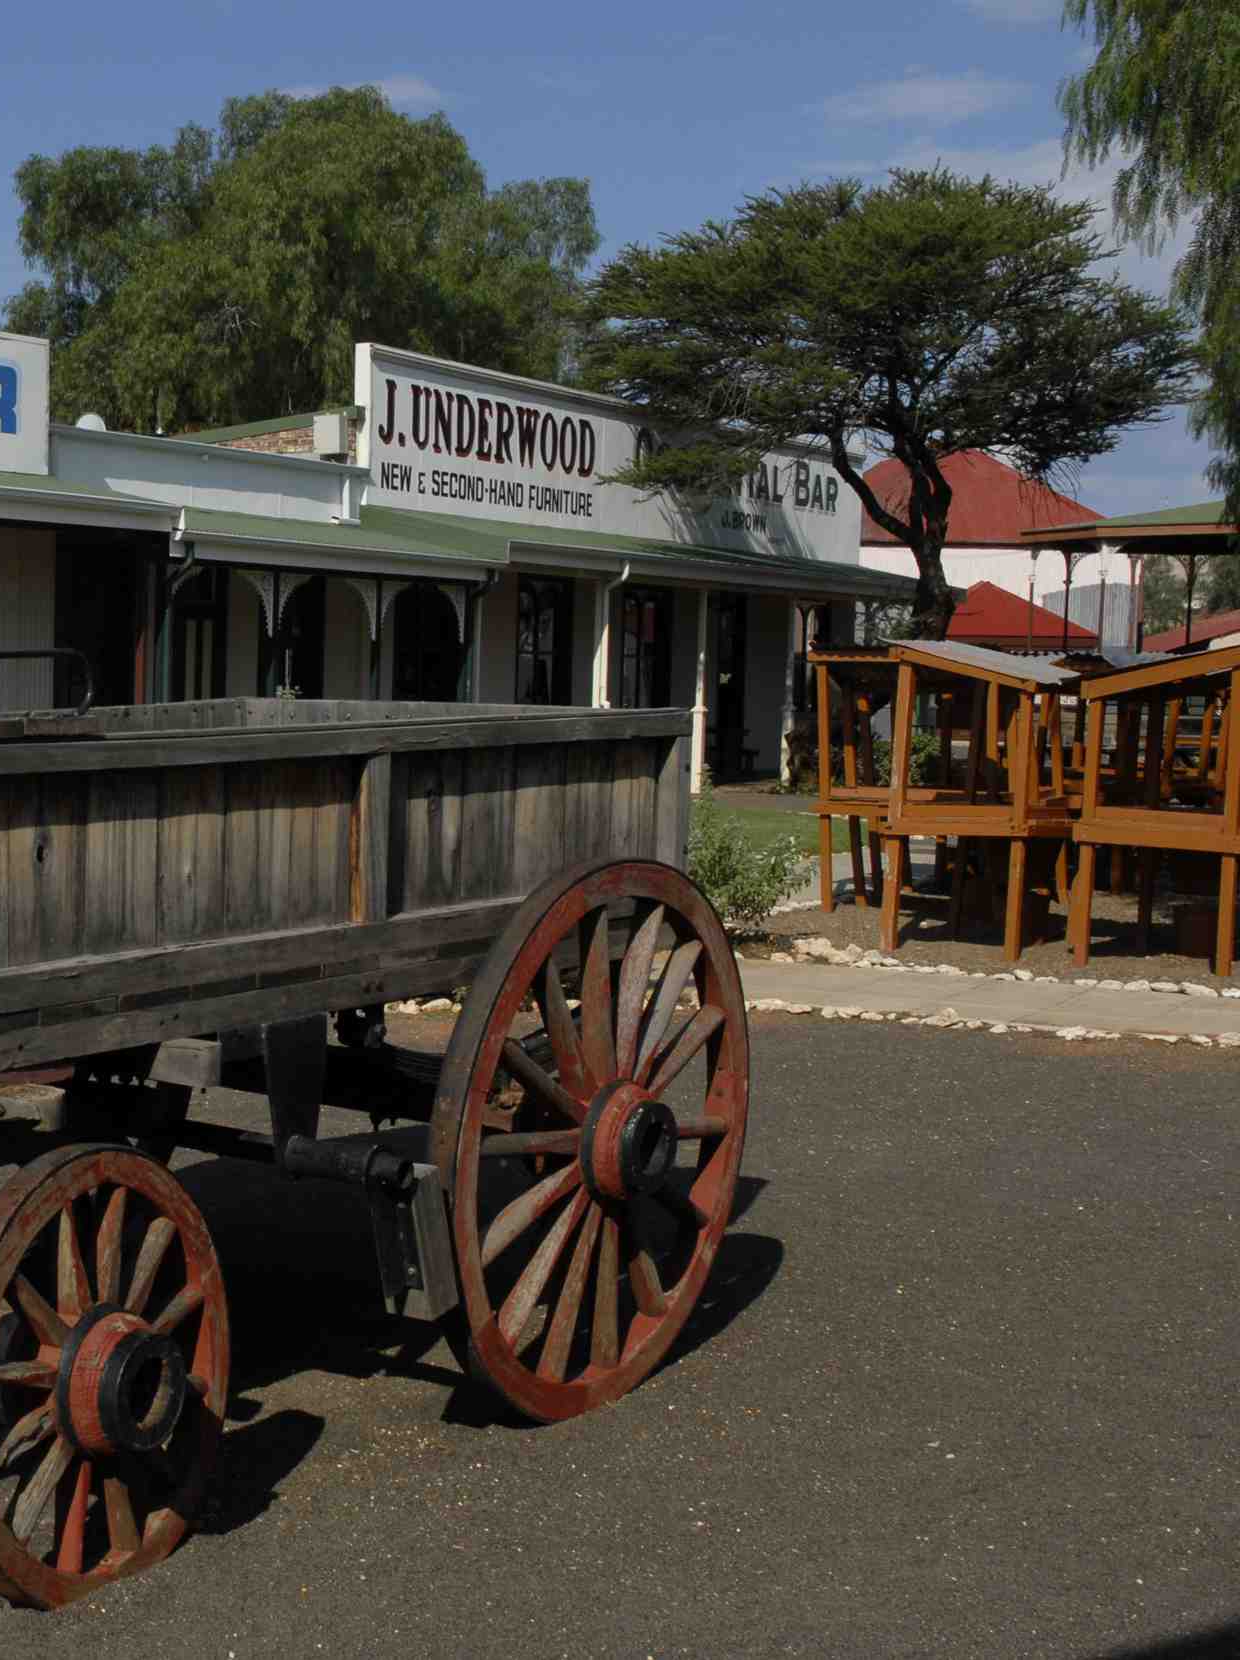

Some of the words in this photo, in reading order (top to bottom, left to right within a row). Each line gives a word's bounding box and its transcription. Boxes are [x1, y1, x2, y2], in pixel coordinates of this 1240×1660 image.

[380, 461, 413, 493] NEW
[528, 484, 593, 518] FURNITURE
[793, 459, 840, 514] BAR
